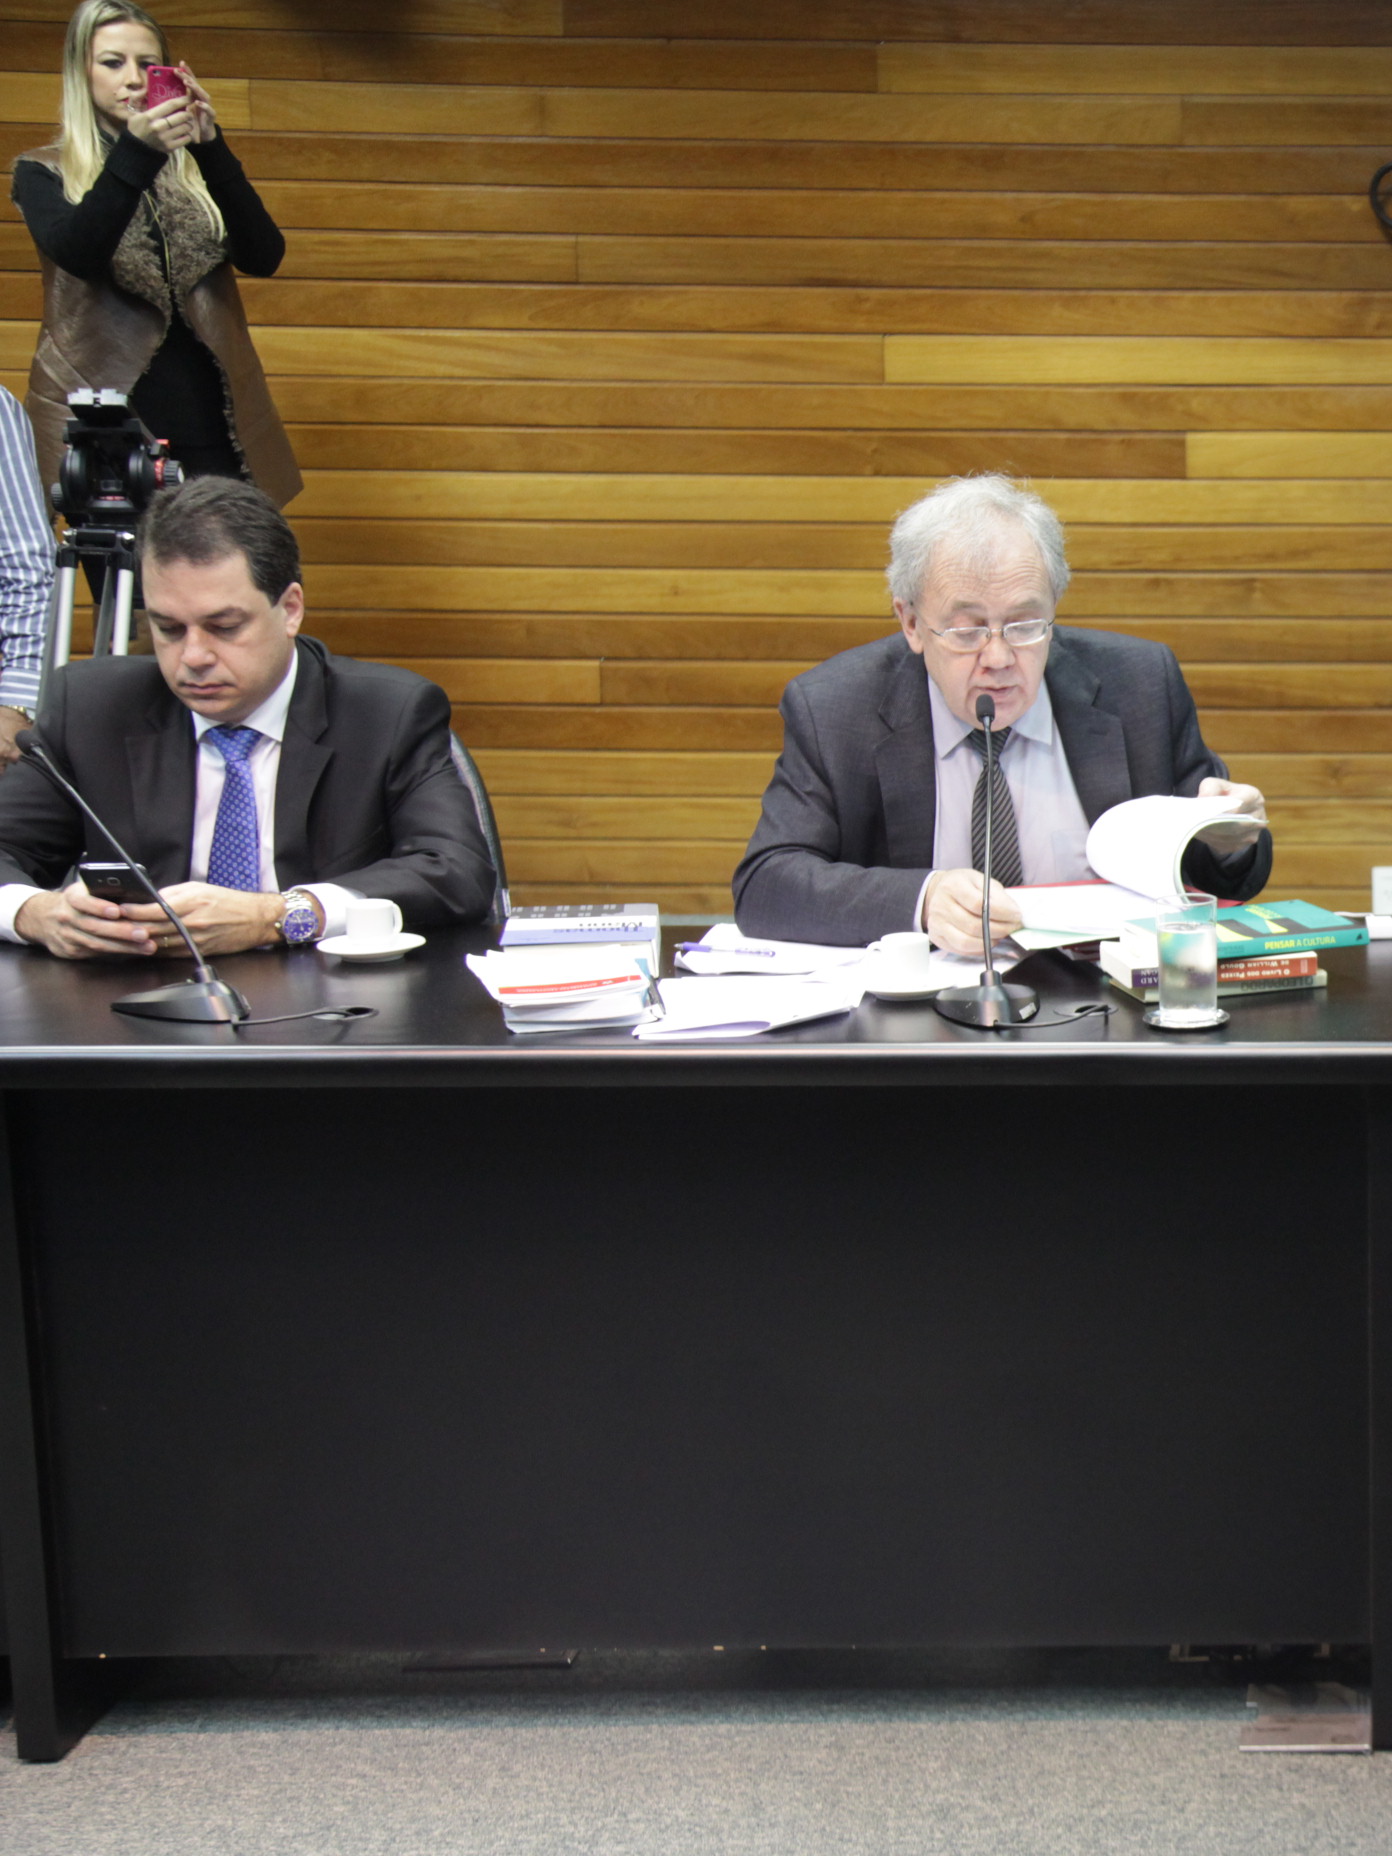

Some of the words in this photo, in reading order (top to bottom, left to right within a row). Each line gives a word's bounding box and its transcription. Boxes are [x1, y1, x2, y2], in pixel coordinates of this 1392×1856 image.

[1265, 939, 1295, 949] PENSAR
[1296, 938, 1302, 946] A
[1303, 936, 1336, 946] CULTURA
